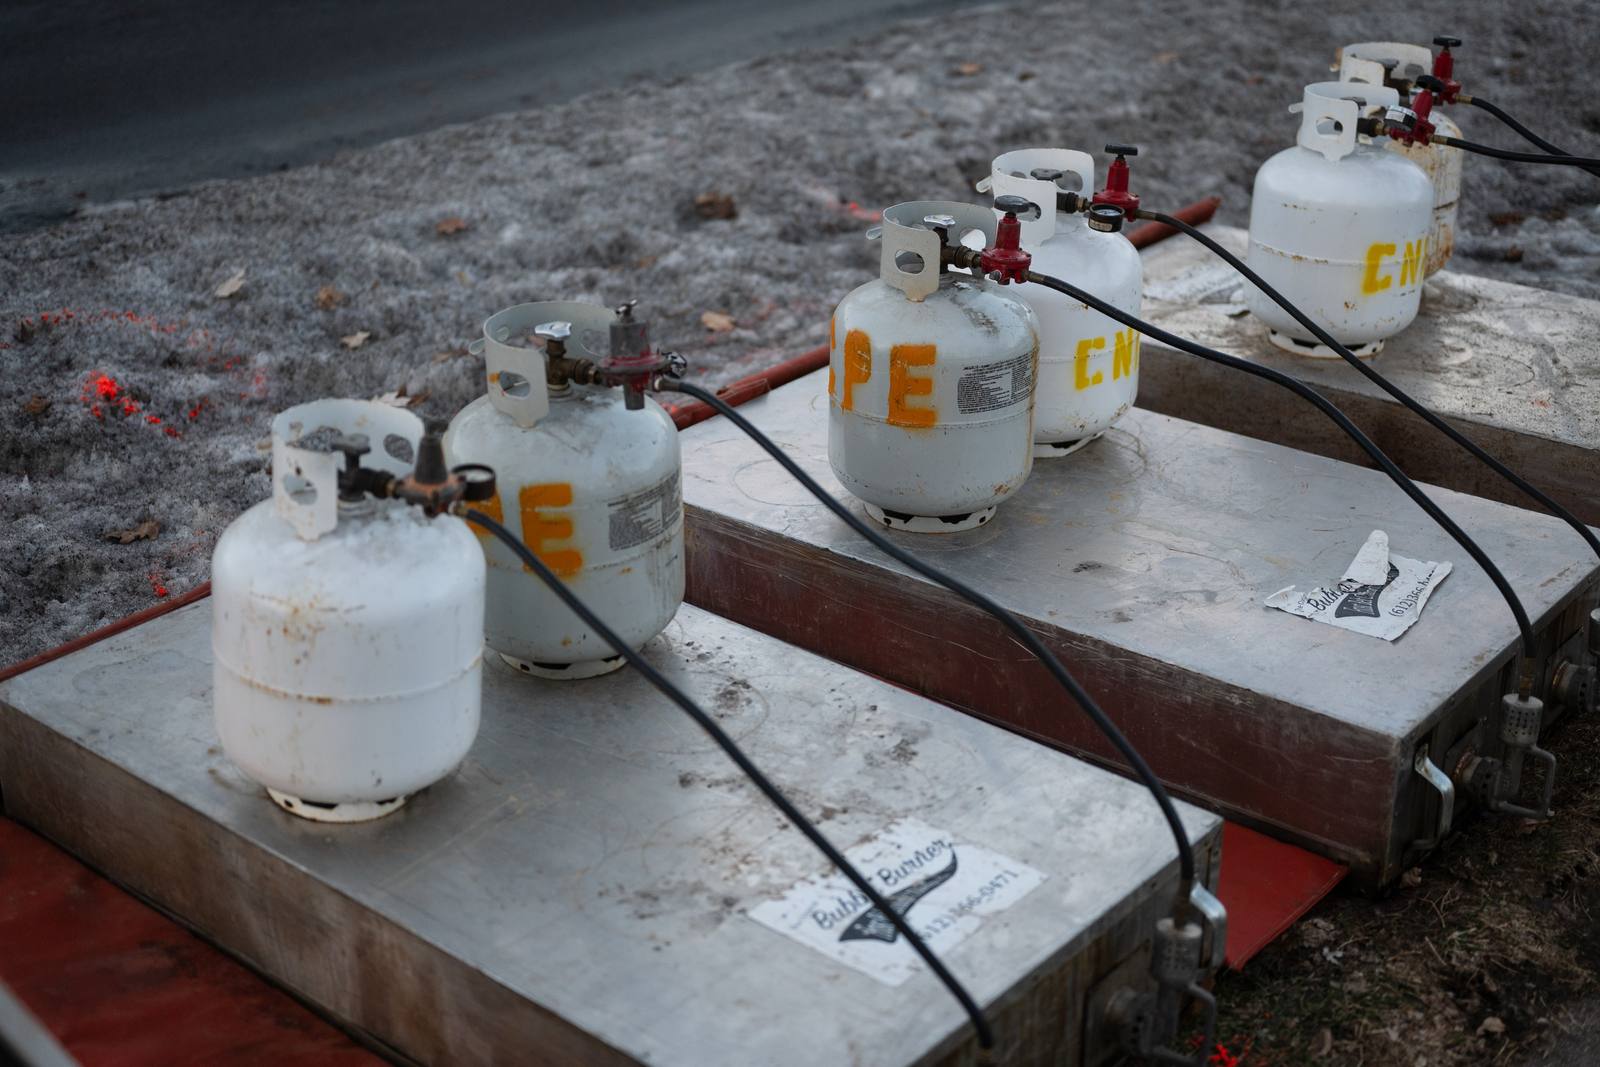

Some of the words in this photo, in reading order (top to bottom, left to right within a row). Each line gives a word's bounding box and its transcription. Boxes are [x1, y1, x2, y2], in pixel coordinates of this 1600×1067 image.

[1362, 238, 1426, 294] CN
[829, 316, 937, 429] PE
[1074, 328, 1139, 390] CN
[877, 839, 948, 887] Burner
